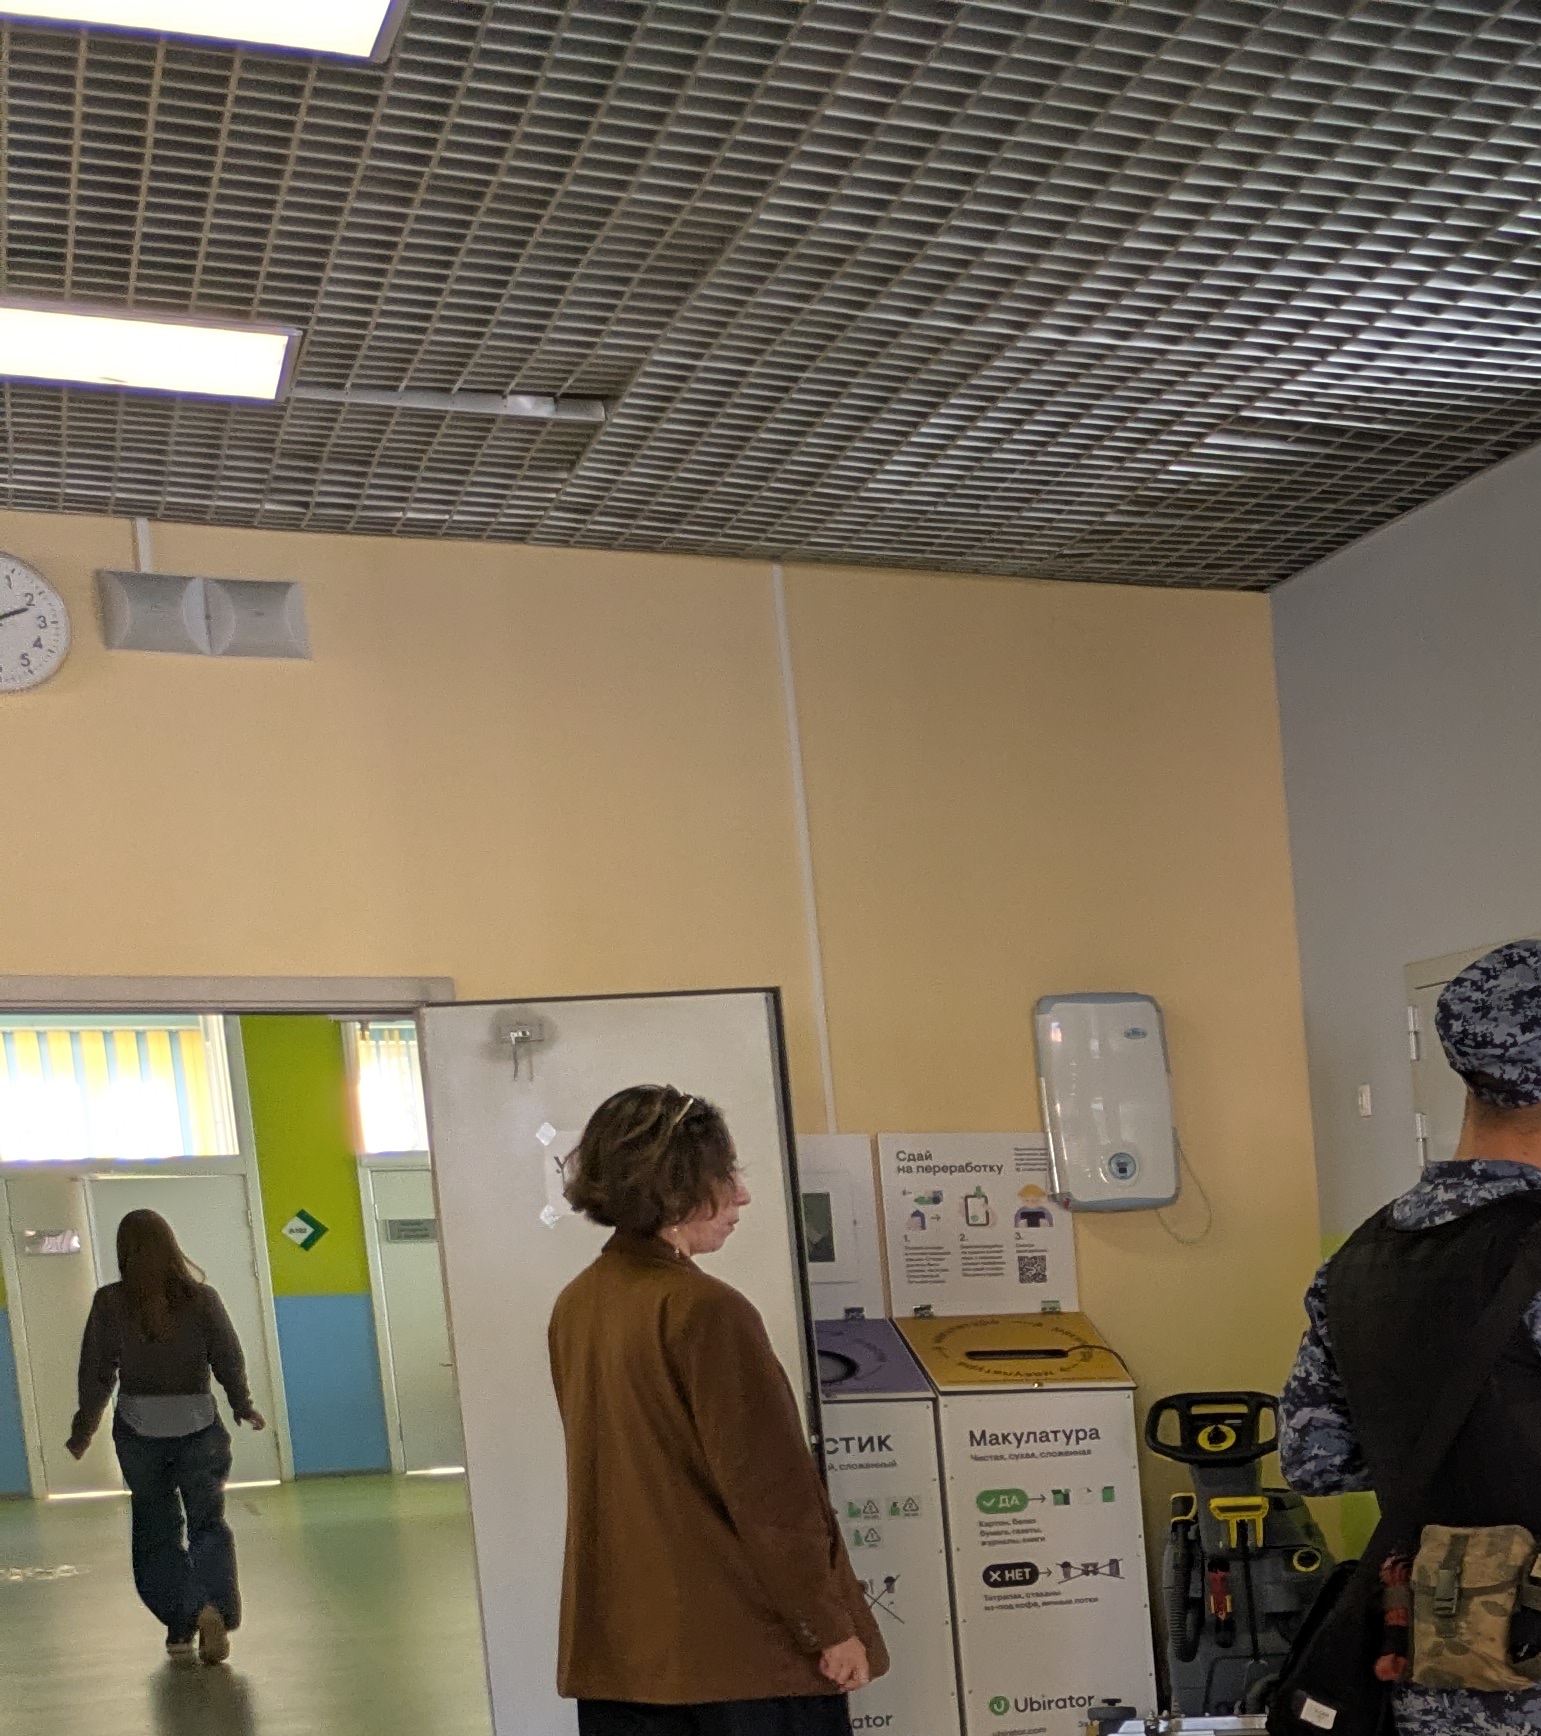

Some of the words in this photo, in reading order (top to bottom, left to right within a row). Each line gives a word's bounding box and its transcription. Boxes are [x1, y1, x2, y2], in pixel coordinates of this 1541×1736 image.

[25, 592, 35, 607] 2
[37, 615, 47, 629] 3
[33, 636, 43, 649] 4
[20, 653, 30, 667] 5
[896, 1150, 932, 1162] Сдай
[897, 1166, 912, 1174] на
[916, 1162, 1003, 1175] переработку
[825, 1434, 893, 1455] СТИК
[969, 1427, 1101, 1449] Макулатура
[998, 1495, 1020, 1508] ДА
[1005, 1568, 1032, 1581] НЕТ
[1014, 1695, 1095, 1713] Ubirator
[852, 1714, 893, 1729] ator
